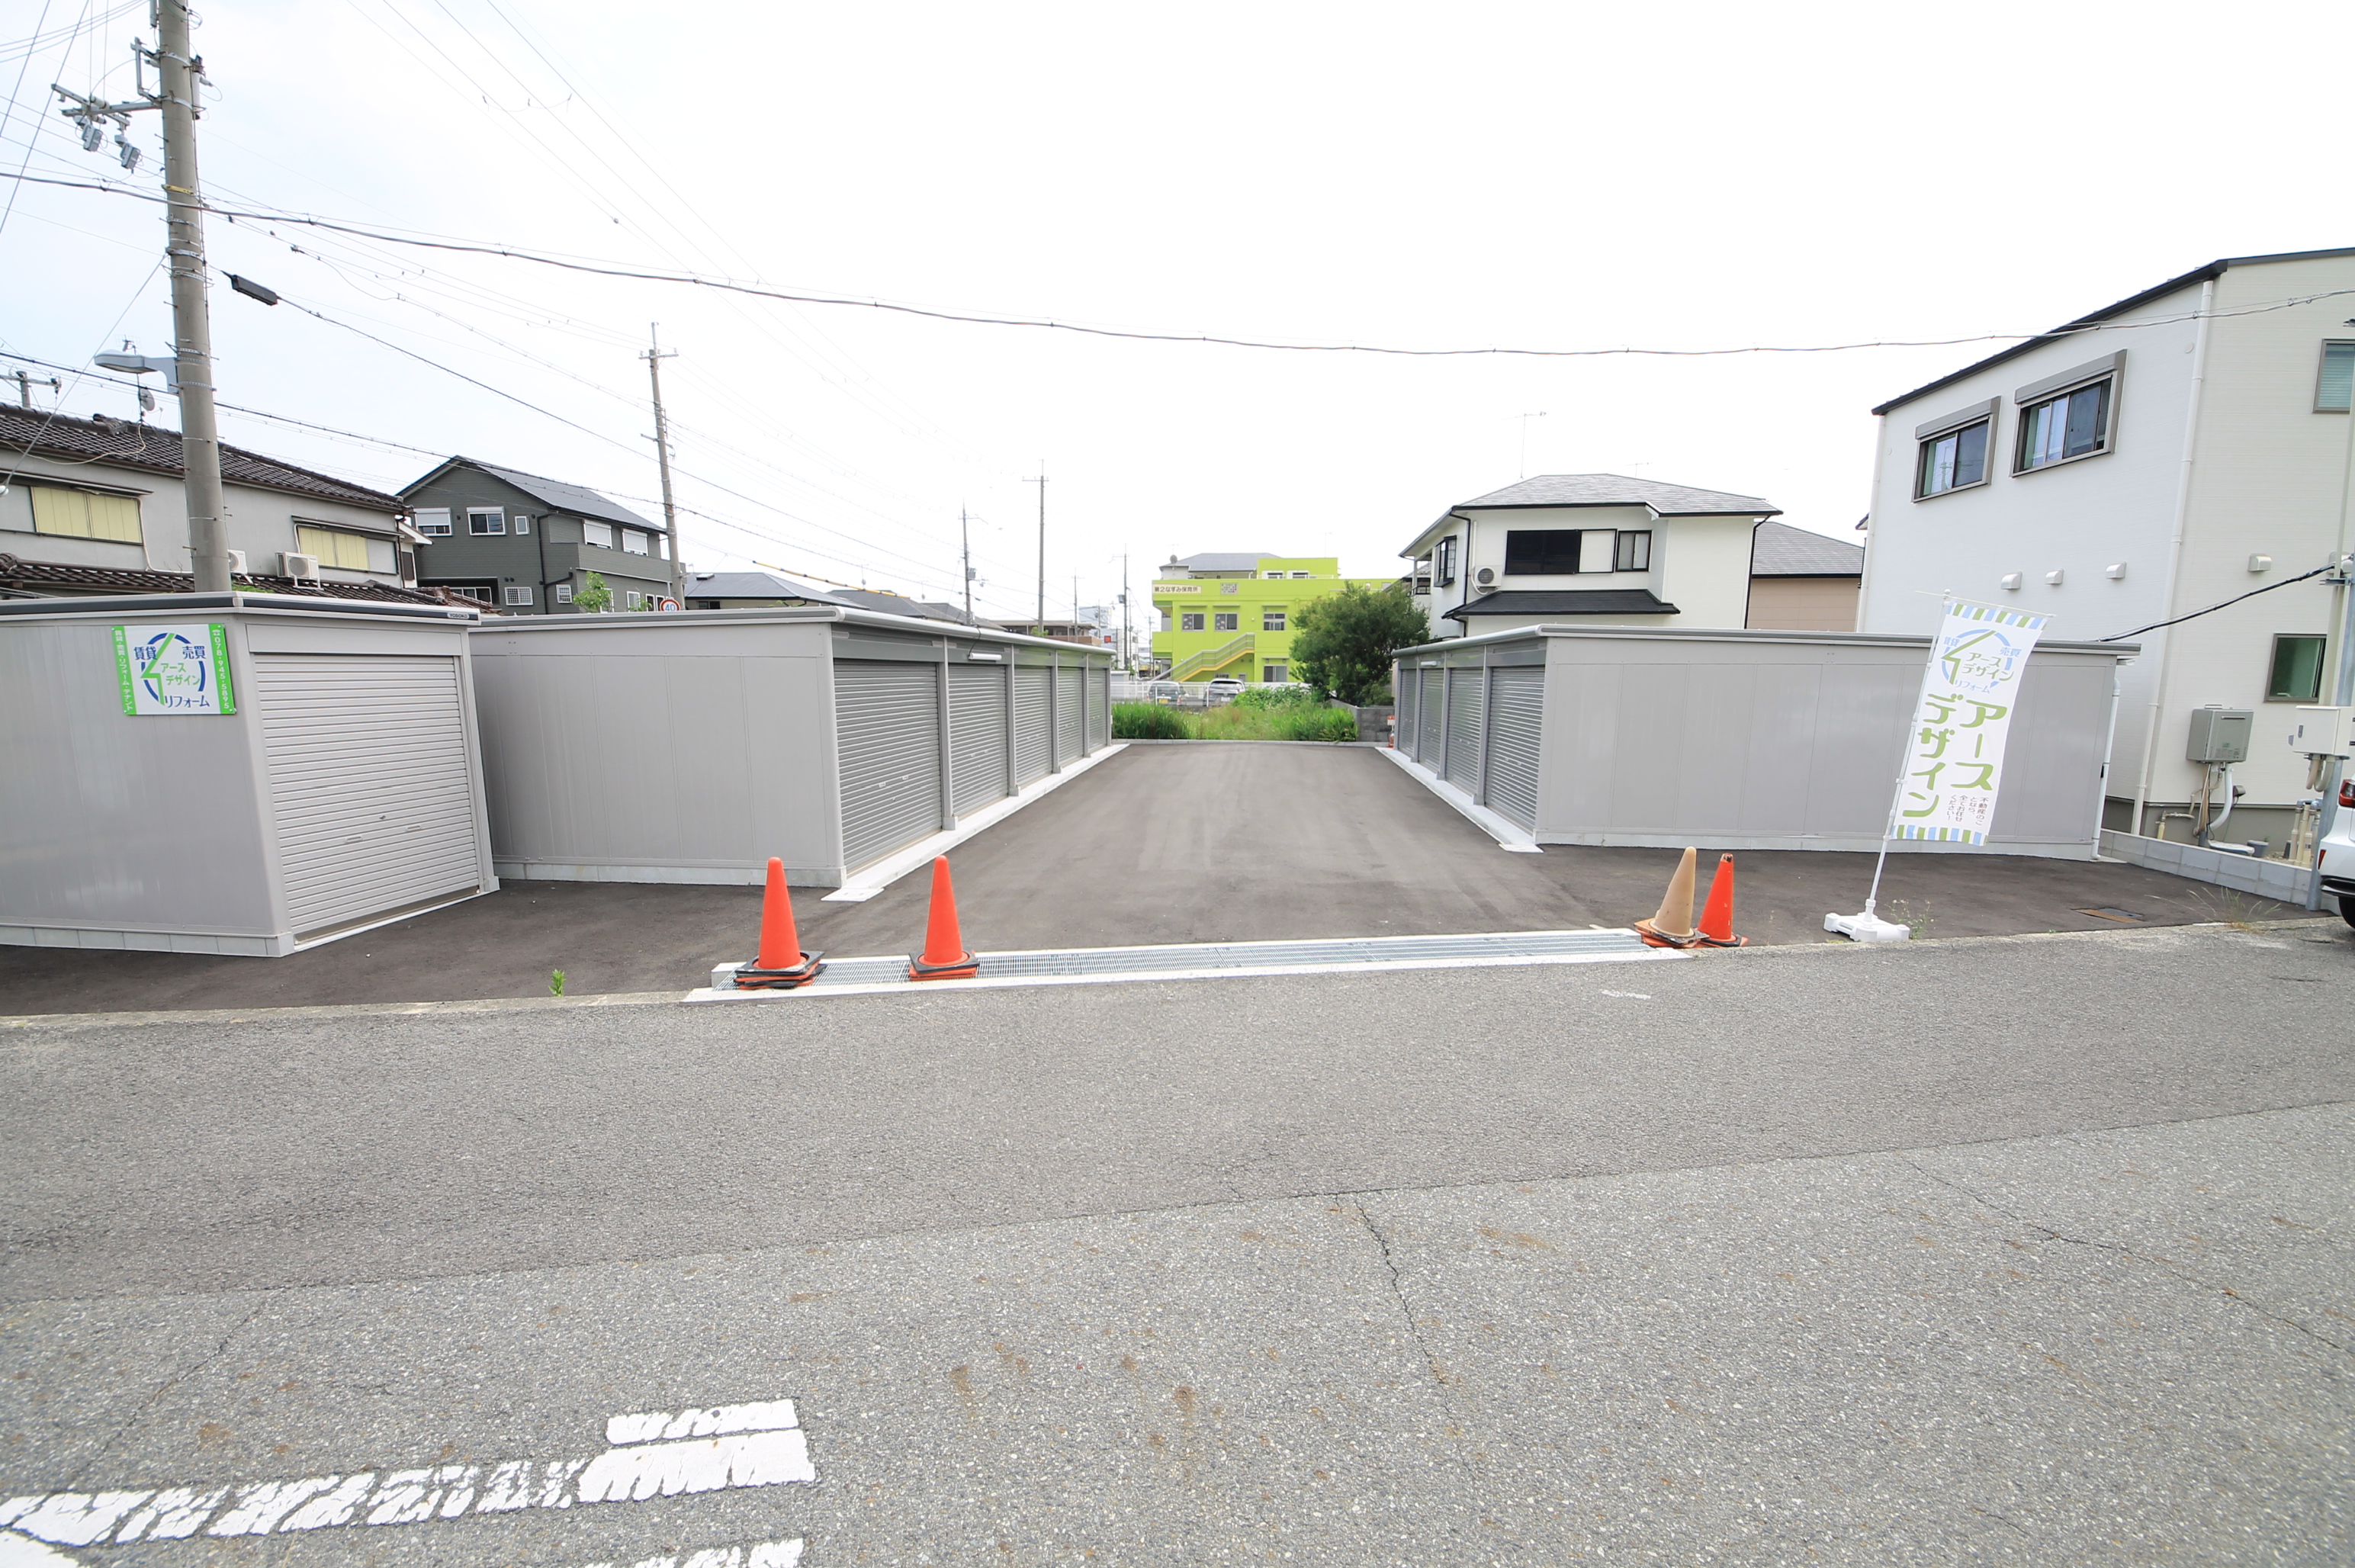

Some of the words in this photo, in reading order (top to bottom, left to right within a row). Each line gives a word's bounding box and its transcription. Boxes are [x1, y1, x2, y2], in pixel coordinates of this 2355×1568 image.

[1943, 636, 1960, 647] 賃貸
[133, 646, 158, 660] 賃貸
[182, 645, 207, 660] 売買
[2000, 647, 2022, 657] 売買
[1965, 652, 2002, 667] アース
[160, 663, 186, 673] アース
[1961, 663, 2015, 681] デザイン
[165, 675, 201, 686] デザイン
[1955, 680, 1990, 694] リフォーム
[165, 695, 210, 708] リフォーム
[1950, 699, 2008, 791] アース
[1902, 692, 1964, 818] デザイン
